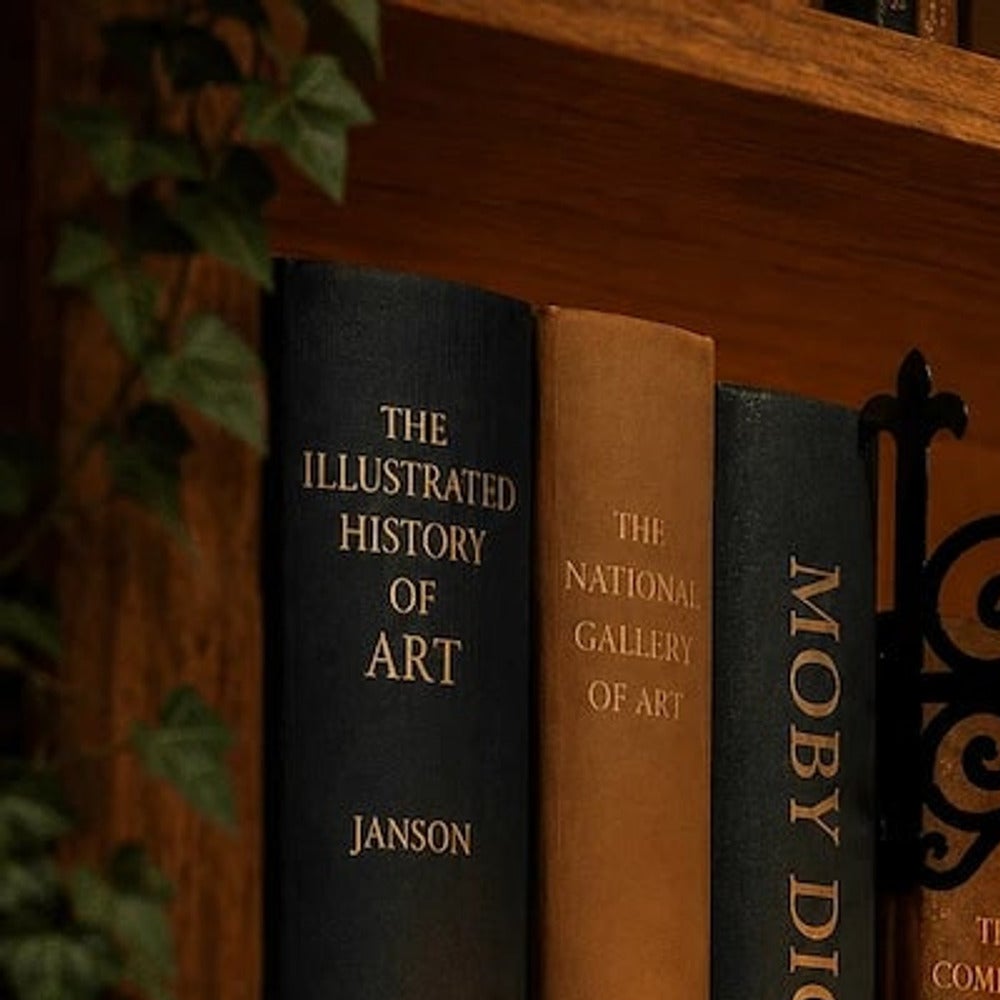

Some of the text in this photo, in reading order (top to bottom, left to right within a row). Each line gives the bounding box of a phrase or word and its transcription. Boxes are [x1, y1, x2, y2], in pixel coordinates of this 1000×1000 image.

[380, 404, 448, 446] THE
[302, 451, 517, 512] ILLUSTRATED
[339, 513, 486, 566] HISTORY
[613, 511, 664, 546] THE
[390, 578, 436, 614] OF
[565, 560, 700, 609] NATIONAL
[365, 632, 461, 686] ART
[575, 620, 693, 666] GALLERY
[588, 680, 684, 720] OF ART
[788, 556, 841, 847] MOBY
[350, 815, 472, 856] JANSON
